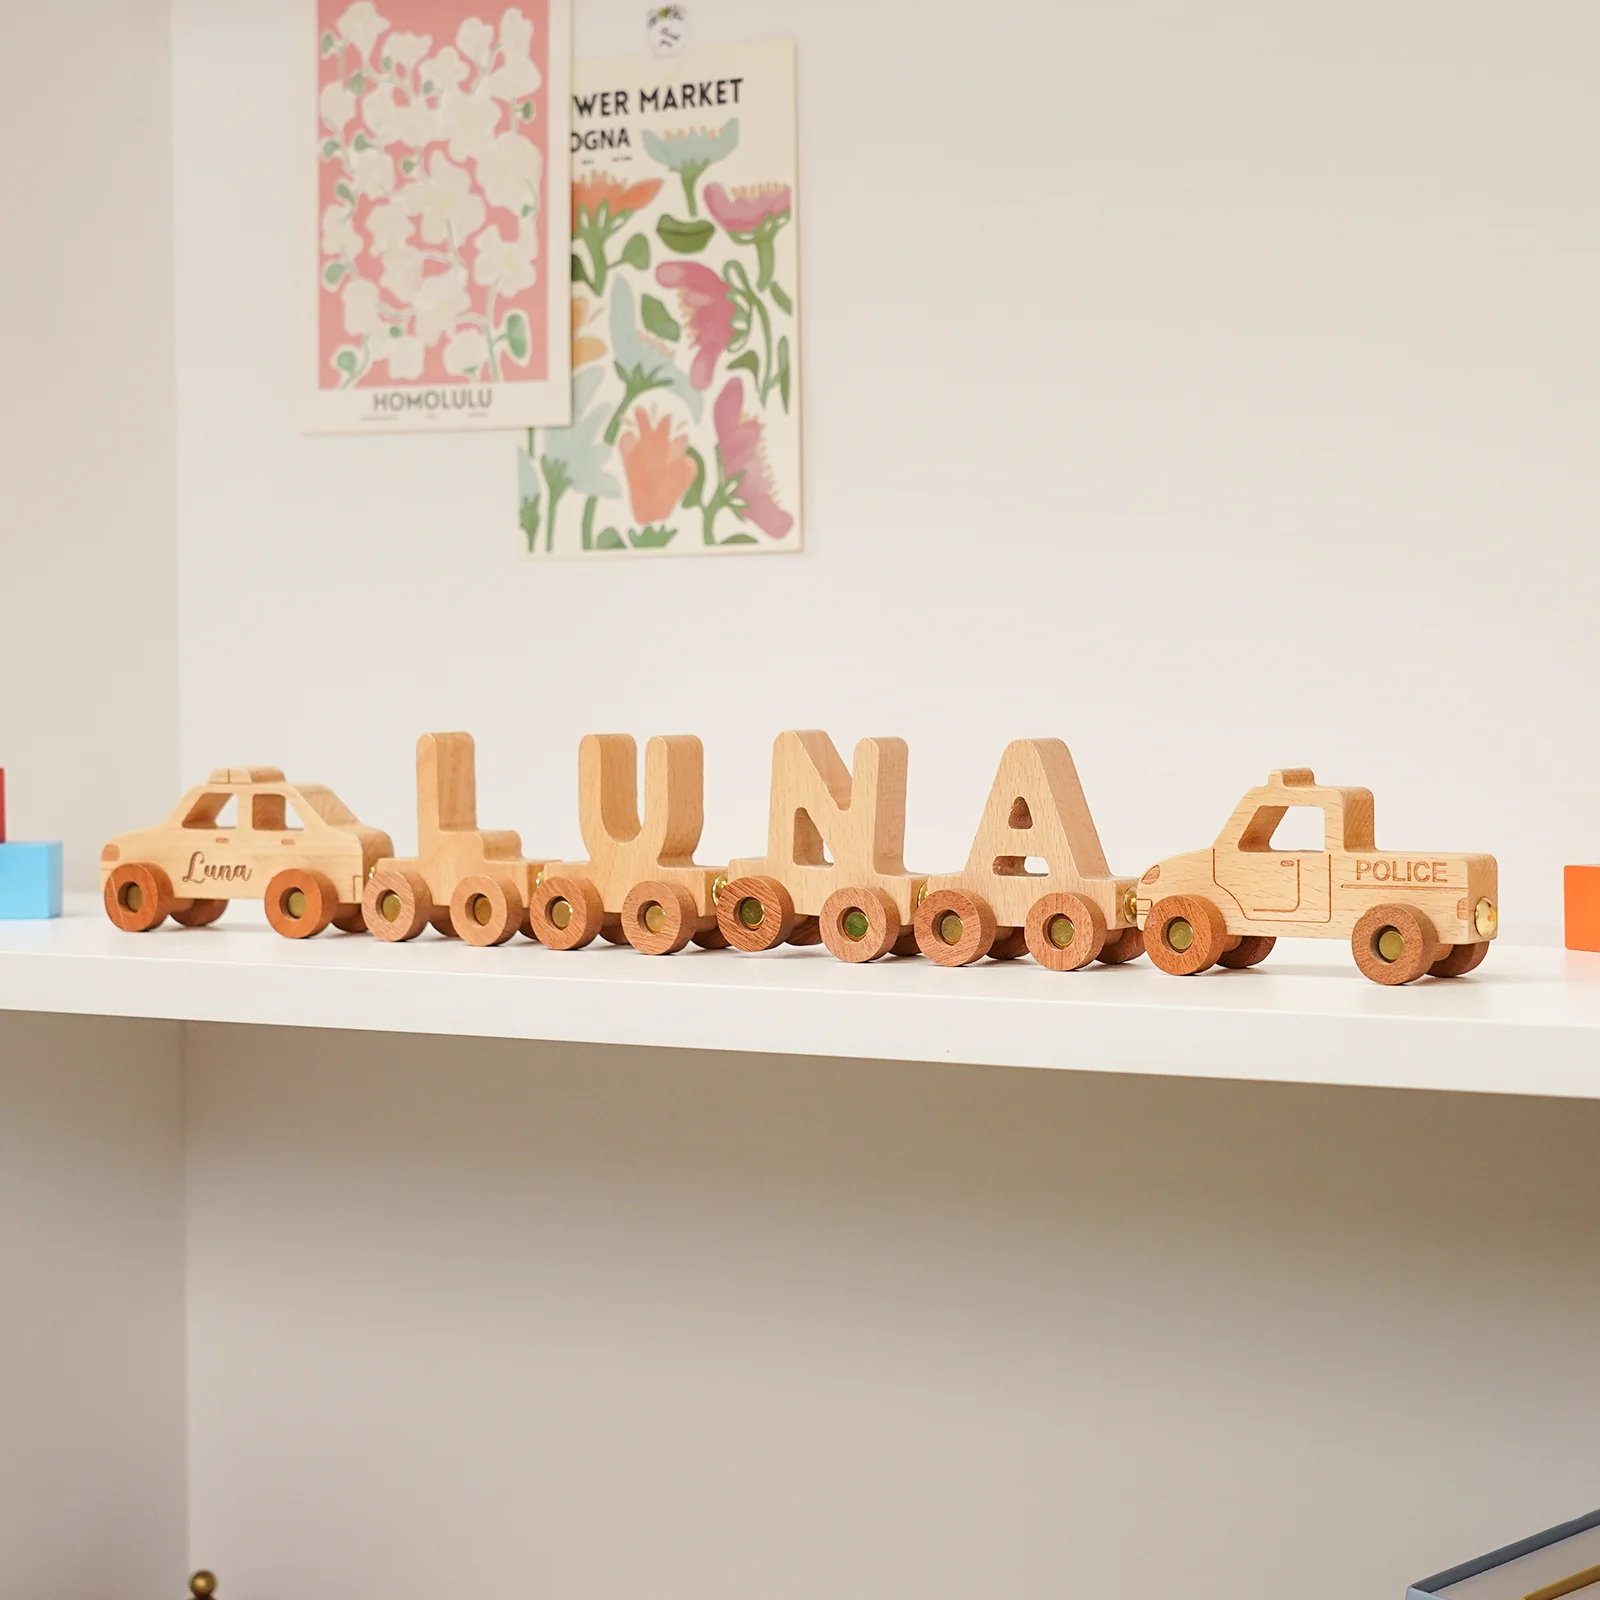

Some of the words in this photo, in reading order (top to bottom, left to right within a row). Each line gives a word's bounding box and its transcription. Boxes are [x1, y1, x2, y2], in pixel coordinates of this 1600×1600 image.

[638, 77, 743, 113] MARKET
[373, 389, 492, 412] HOMOLULU
[182, 851, 252, 884] Luna
[1356, 860, 1448, 882] POLICE
